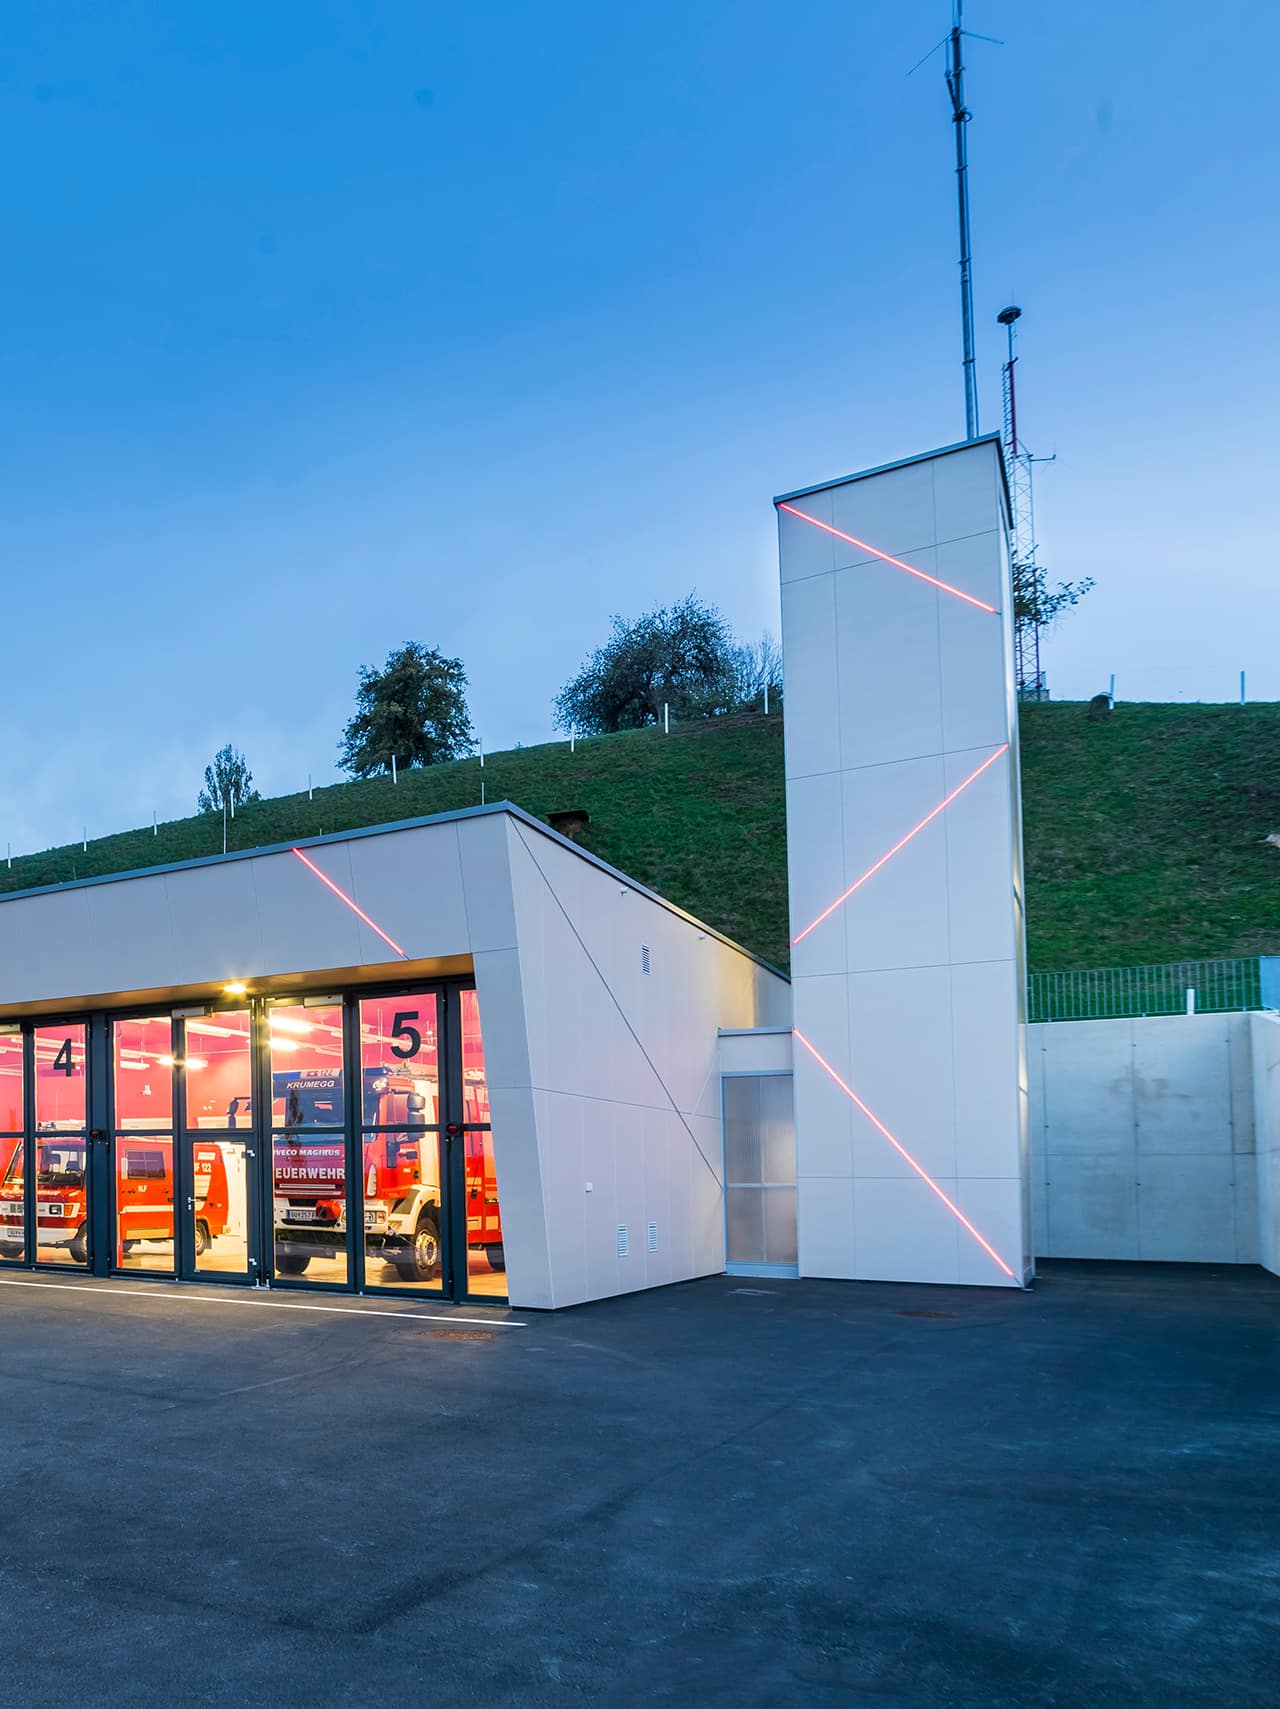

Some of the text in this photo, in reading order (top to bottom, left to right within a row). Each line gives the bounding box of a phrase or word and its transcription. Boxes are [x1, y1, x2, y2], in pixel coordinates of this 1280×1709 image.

[390, 1011, 421, 1058] 5
[53, 1038, 76, 1077] 4
[286, 1080, 335, 1089] KRUMEGG
[299, 1149, 340, 1157] MAGIRUS
[274, 1167, 345, 1179] EUERWEHR
